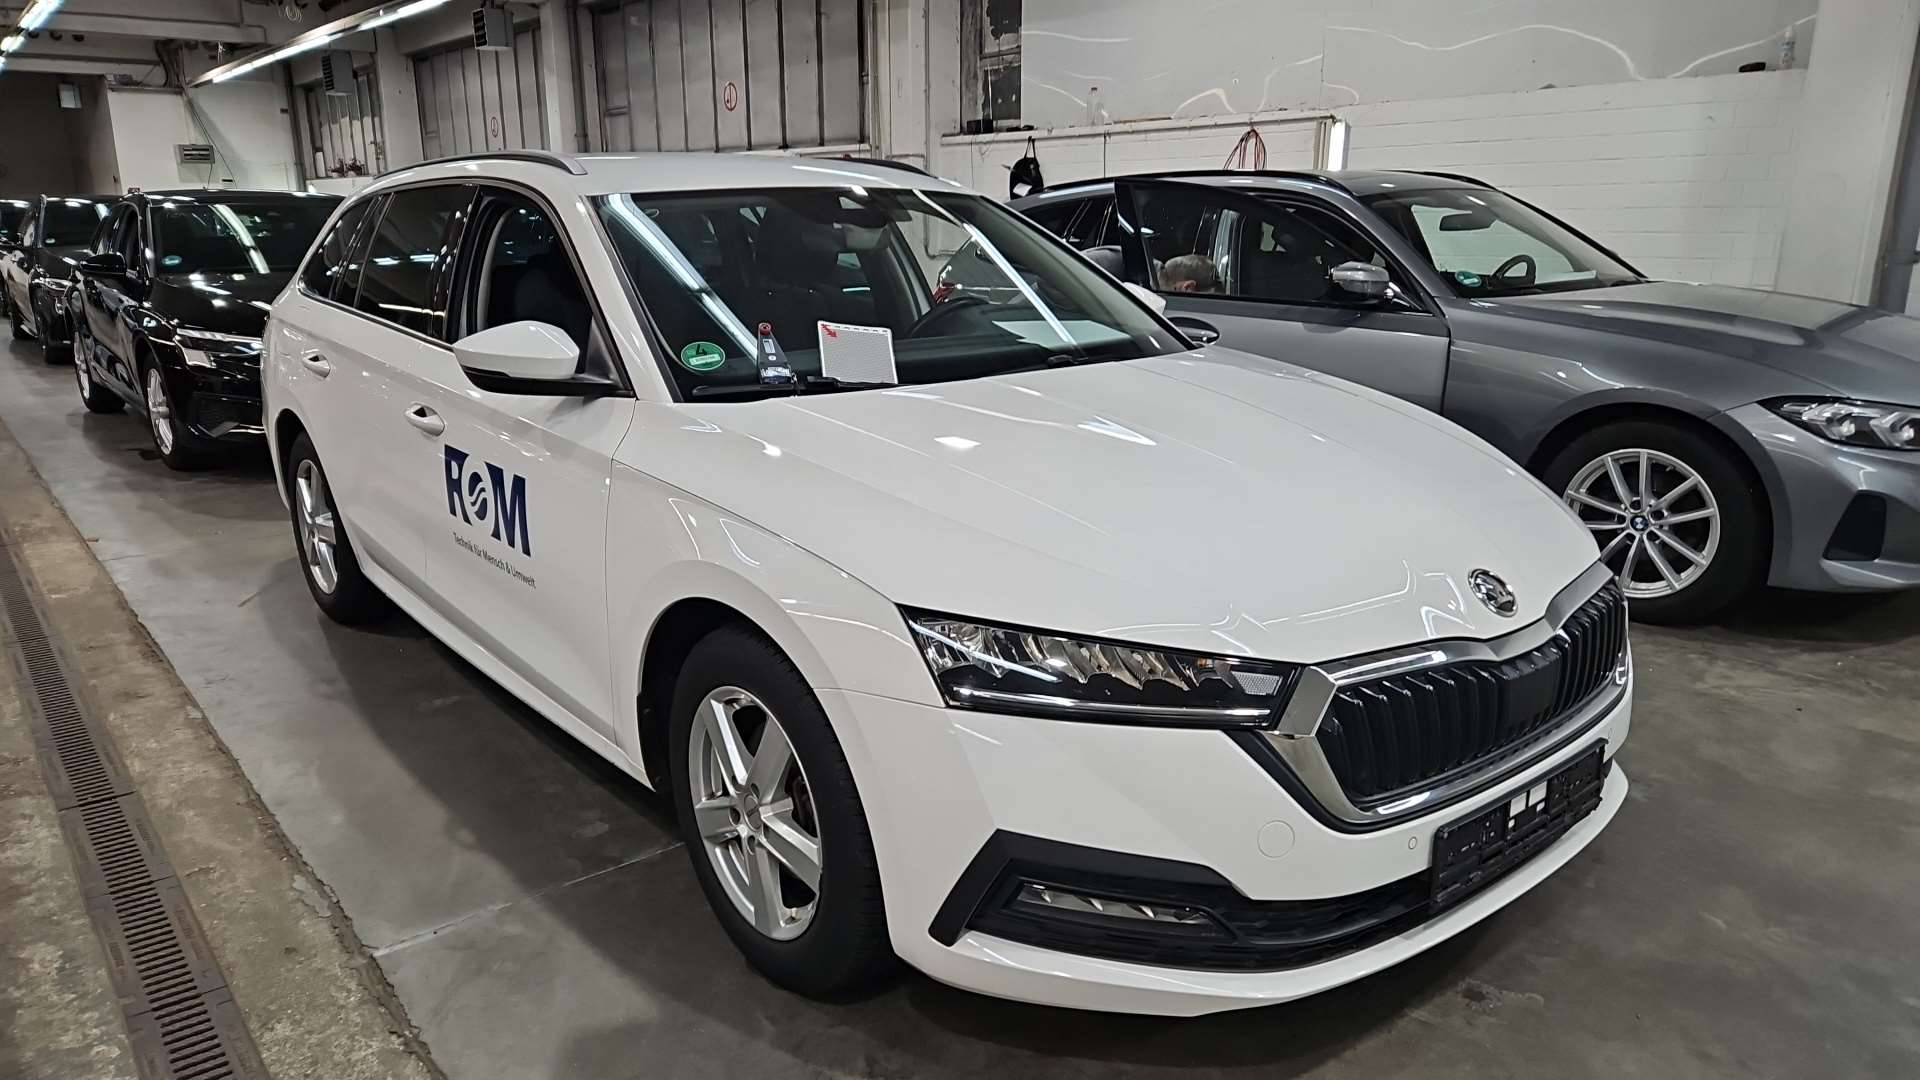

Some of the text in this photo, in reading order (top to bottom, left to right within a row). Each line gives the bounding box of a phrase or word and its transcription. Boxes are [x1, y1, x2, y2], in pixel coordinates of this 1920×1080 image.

[695, 343, 707, 356] 4
[453, 531, 474, 552] Technik
[482, 548, 506, 571] Mensch
[505, 561, 511, 574] &
[510, 565, 537, 589] Umwelt
